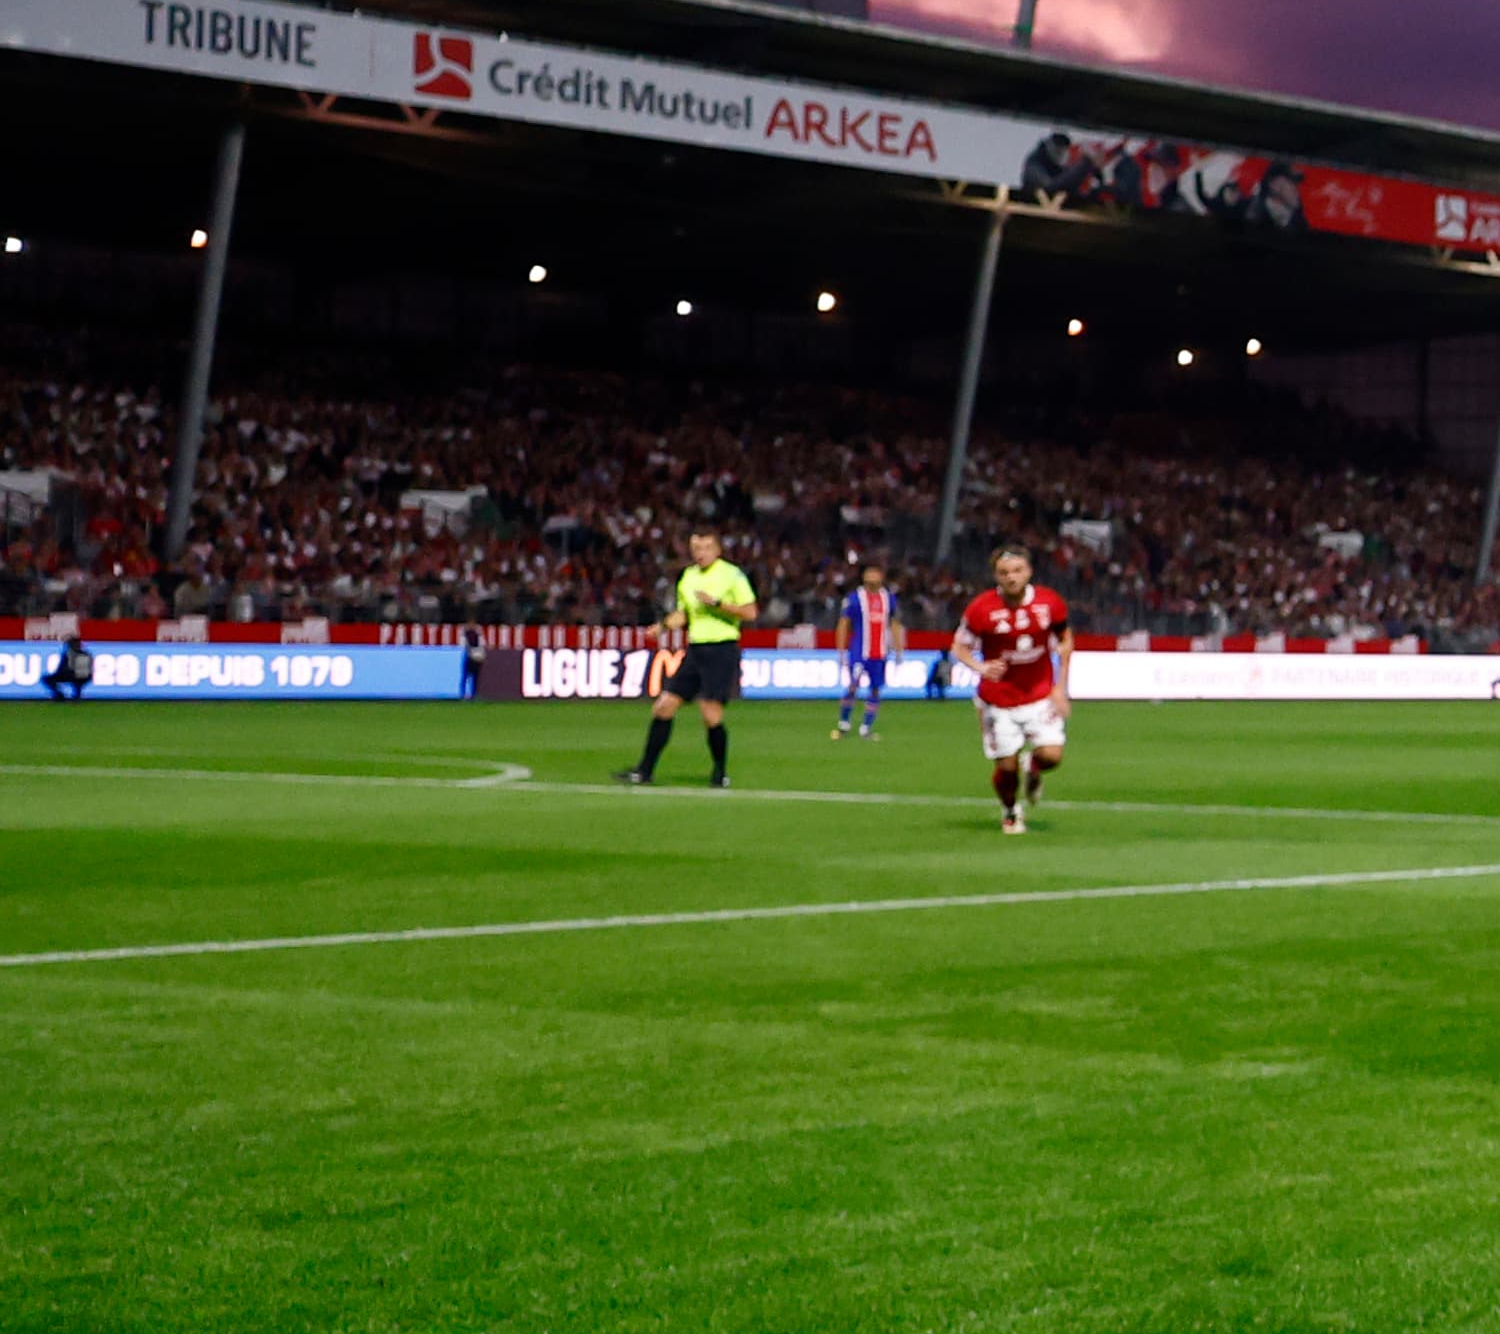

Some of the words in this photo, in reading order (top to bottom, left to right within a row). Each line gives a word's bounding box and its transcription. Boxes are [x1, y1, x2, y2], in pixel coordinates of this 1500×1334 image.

[487, 59, 610, 111] Crédit
[619, 78, 754, 131] Mutuel
[764, 97, 938, 164] ARKEA
[146, 654, 266, 686] DEPUIS
